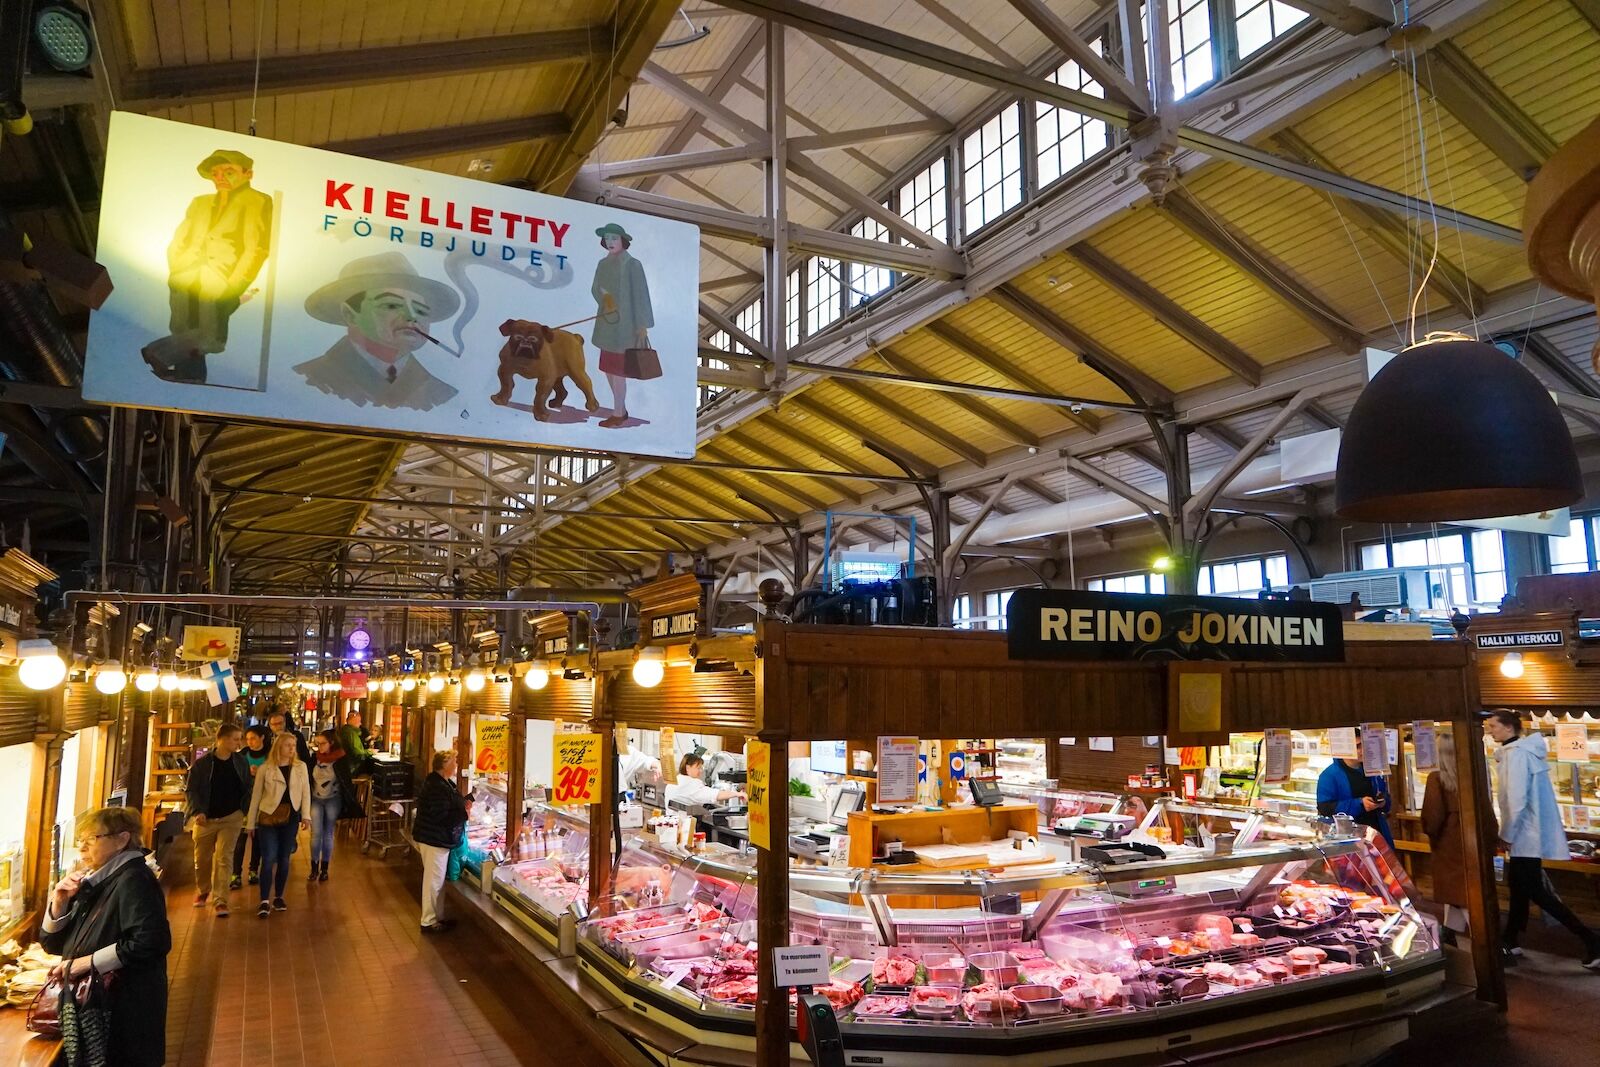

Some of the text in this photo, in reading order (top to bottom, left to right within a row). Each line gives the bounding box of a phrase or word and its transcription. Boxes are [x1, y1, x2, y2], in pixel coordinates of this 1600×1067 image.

[325, 180, 570, 247] KIELLETTY
[324, 215, 568, 270] FÖRBJUDET
[652, 613, 697, 637] REINO JOKINEN
[1041, 607, 1324, 645] REINO JOKINEN
[1480, 634, 1559, 646] HALLIN HERKKU
